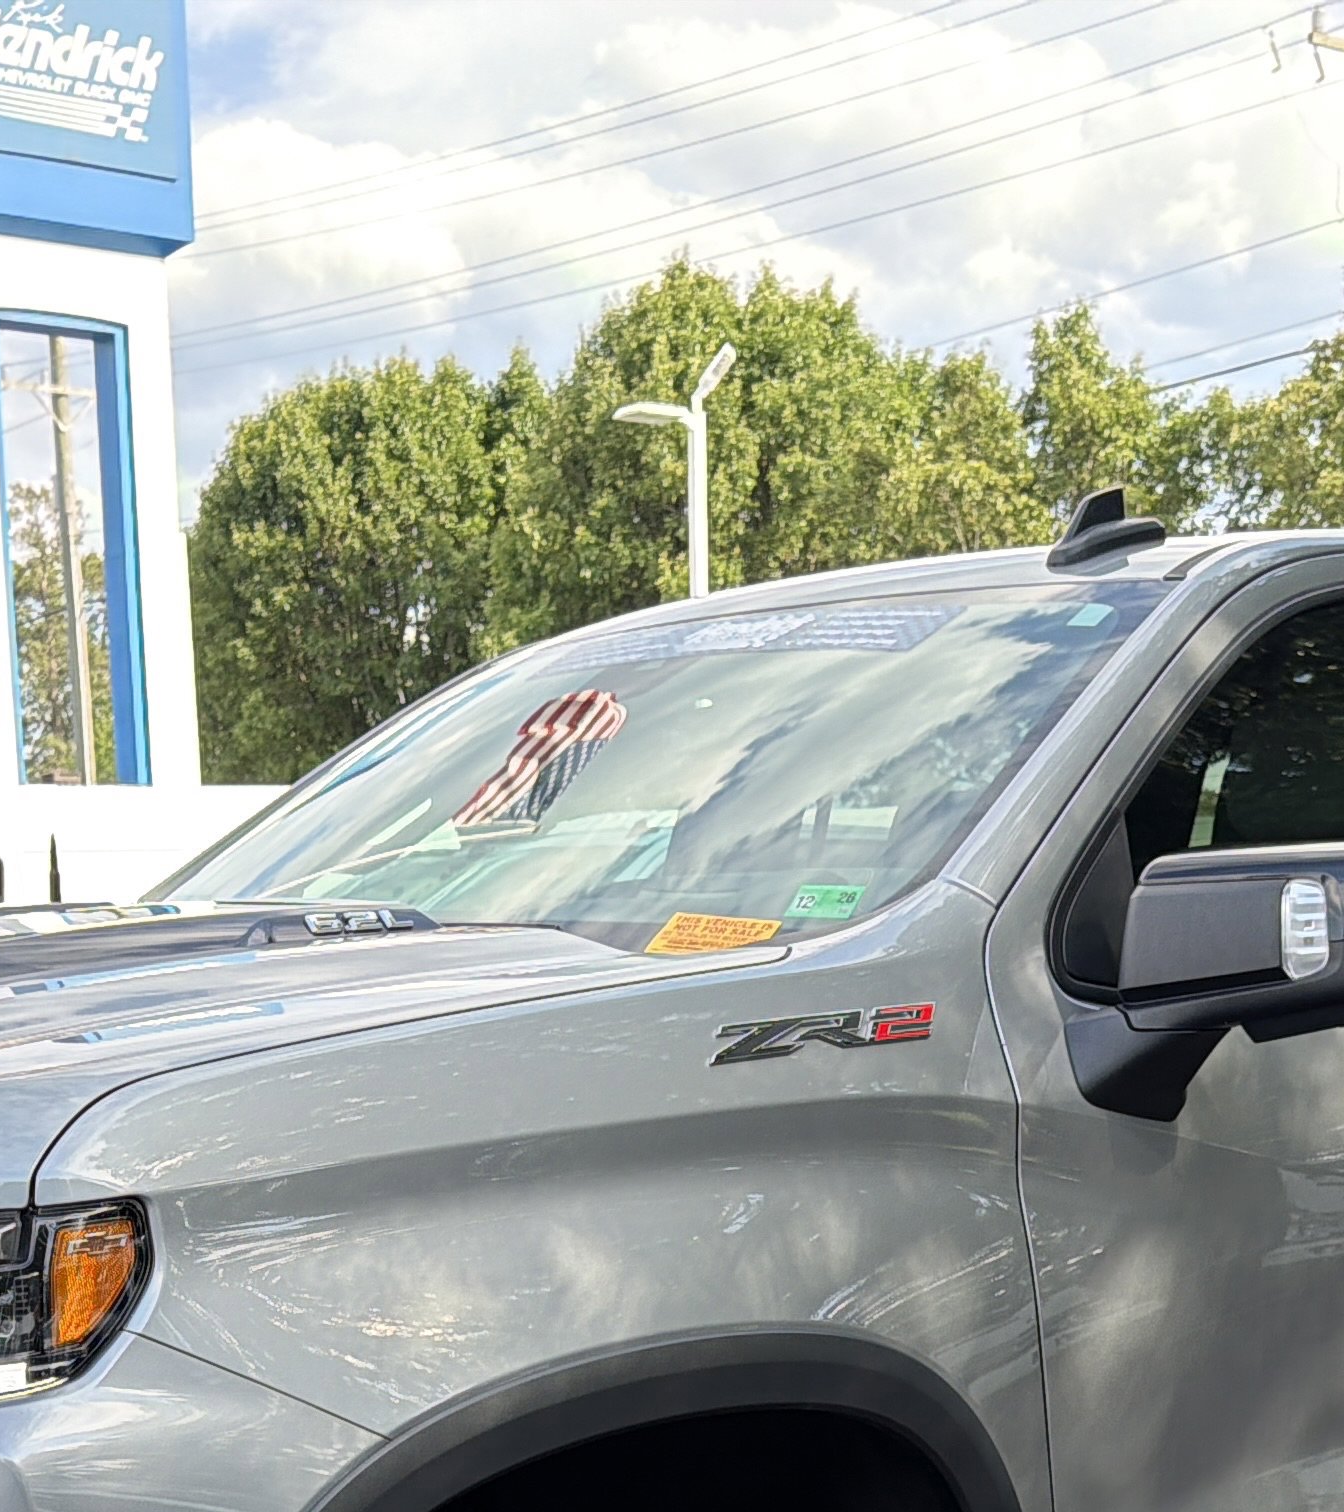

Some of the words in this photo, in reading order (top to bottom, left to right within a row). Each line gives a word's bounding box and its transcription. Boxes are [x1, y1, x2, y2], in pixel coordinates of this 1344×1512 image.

[73, 82, 117, 101] BUICK
[118, 89, 152, 107] GMC
[796, 895, 816, 909] 12
[674, 924, 698, 932] NOT
[701, 926, 729, 935] FOR
[729, 929, 765, 938] SALE
[676, 915, 703, 924] THIS
[707, 917, 759, 929] VEHICLE
[762, 922, 774, 931] IS
[706, 1001, 936, 1066] ZR2
